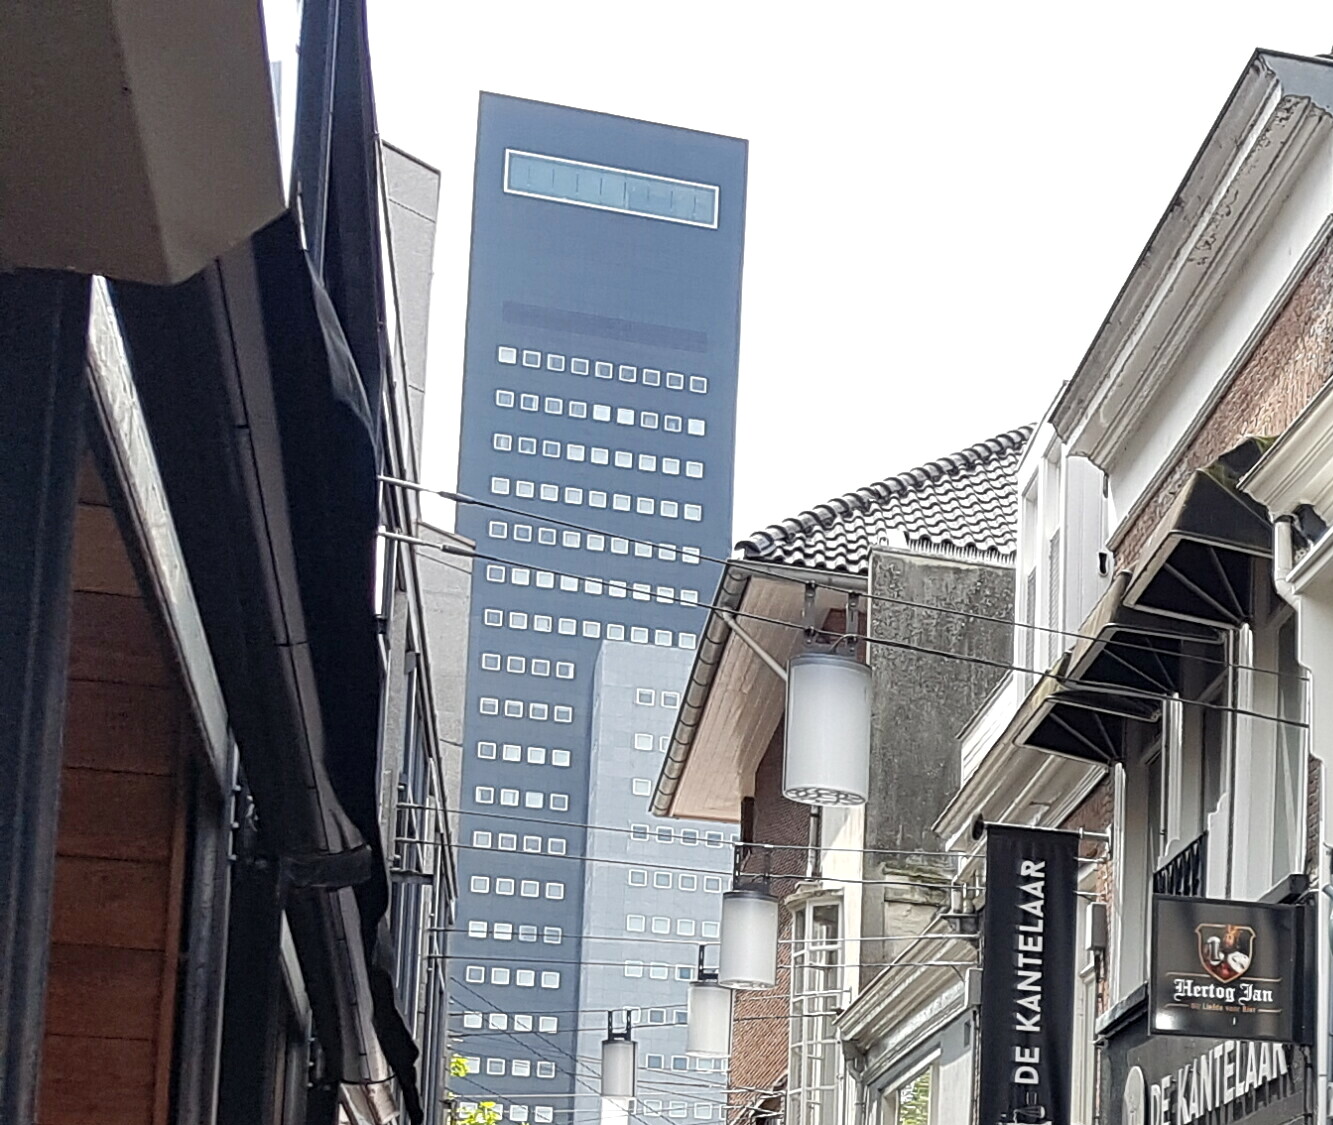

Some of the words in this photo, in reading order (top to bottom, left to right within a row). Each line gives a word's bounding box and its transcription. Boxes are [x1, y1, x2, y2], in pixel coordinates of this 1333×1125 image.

[1014, 858, 1046, 1034] KANTELAAR
[1173, 978, 1236, 1003] Hertog
[1238, 982, 1274, 1006] Jan
[1013, 1046, 1040, 1086] DE
